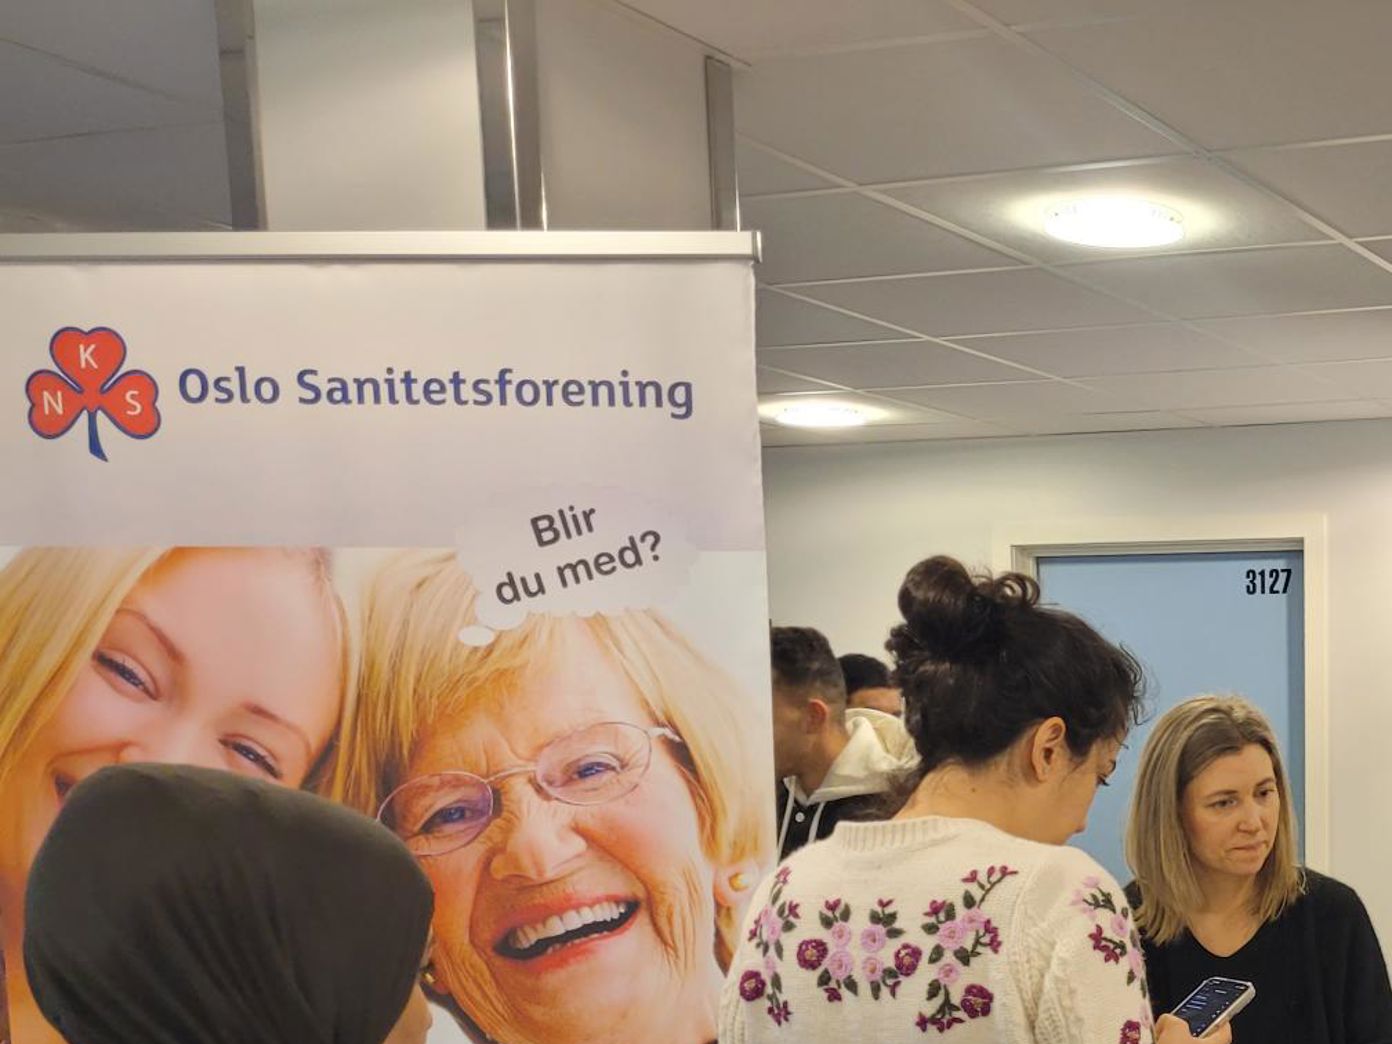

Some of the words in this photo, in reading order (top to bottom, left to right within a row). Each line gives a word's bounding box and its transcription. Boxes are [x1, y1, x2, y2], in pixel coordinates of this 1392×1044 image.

[78, 344, 96, 369] K
[43, 391, 63, 416] N
[126, 391, 141, 416] S
[178, 366, 280, 404] Oslo
[297, 367, 694, 419] Sanitetsforening
[530, 504, 597, 549] Blir
[494, 564, 546, 606] du
[557, 529, 663, 592] med?
[1246, 568, 1292, 595] 3127
